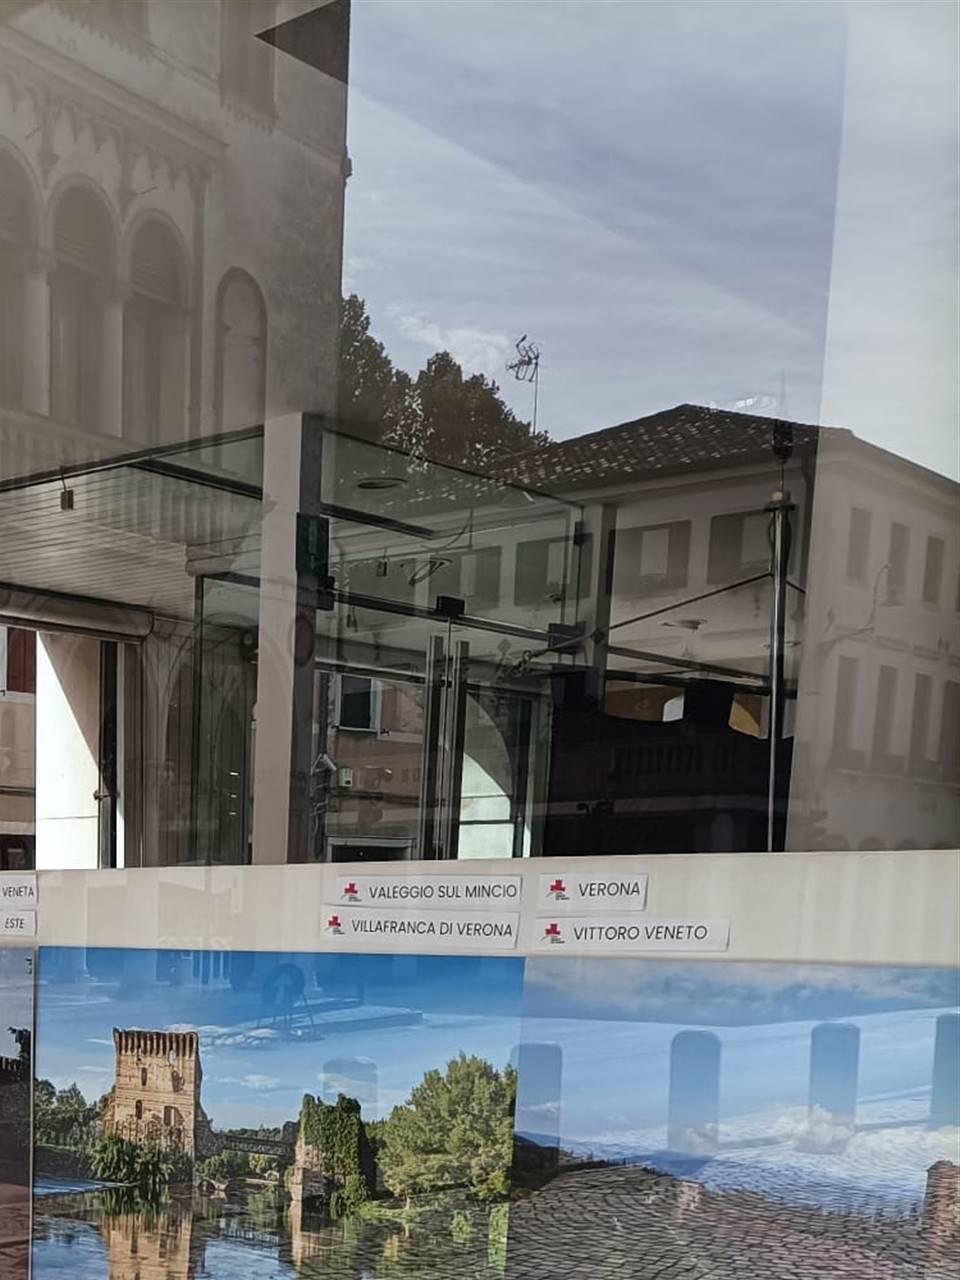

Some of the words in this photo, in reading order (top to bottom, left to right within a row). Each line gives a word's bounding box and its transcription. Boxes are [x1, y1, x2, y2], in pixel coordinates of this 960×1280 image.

[2, 885, 34, 898] VENETA
[368, 884, 435, 899] VALEGGIO
[438, 884, 462, 899] SUL
[465, 883, 518, 898] MINCIO
[578, 881, 640, 897] VERONA
[4, 916, 25, 929] ESTE
[351, 918, 436, 935] VILLAFRANCA
[439, 921, 453, 935] DI
[457, 921, 513, 937] VERONA
[573, 925, 640, 941] VITTORO
[644, 924, 708, 940] VENETO
